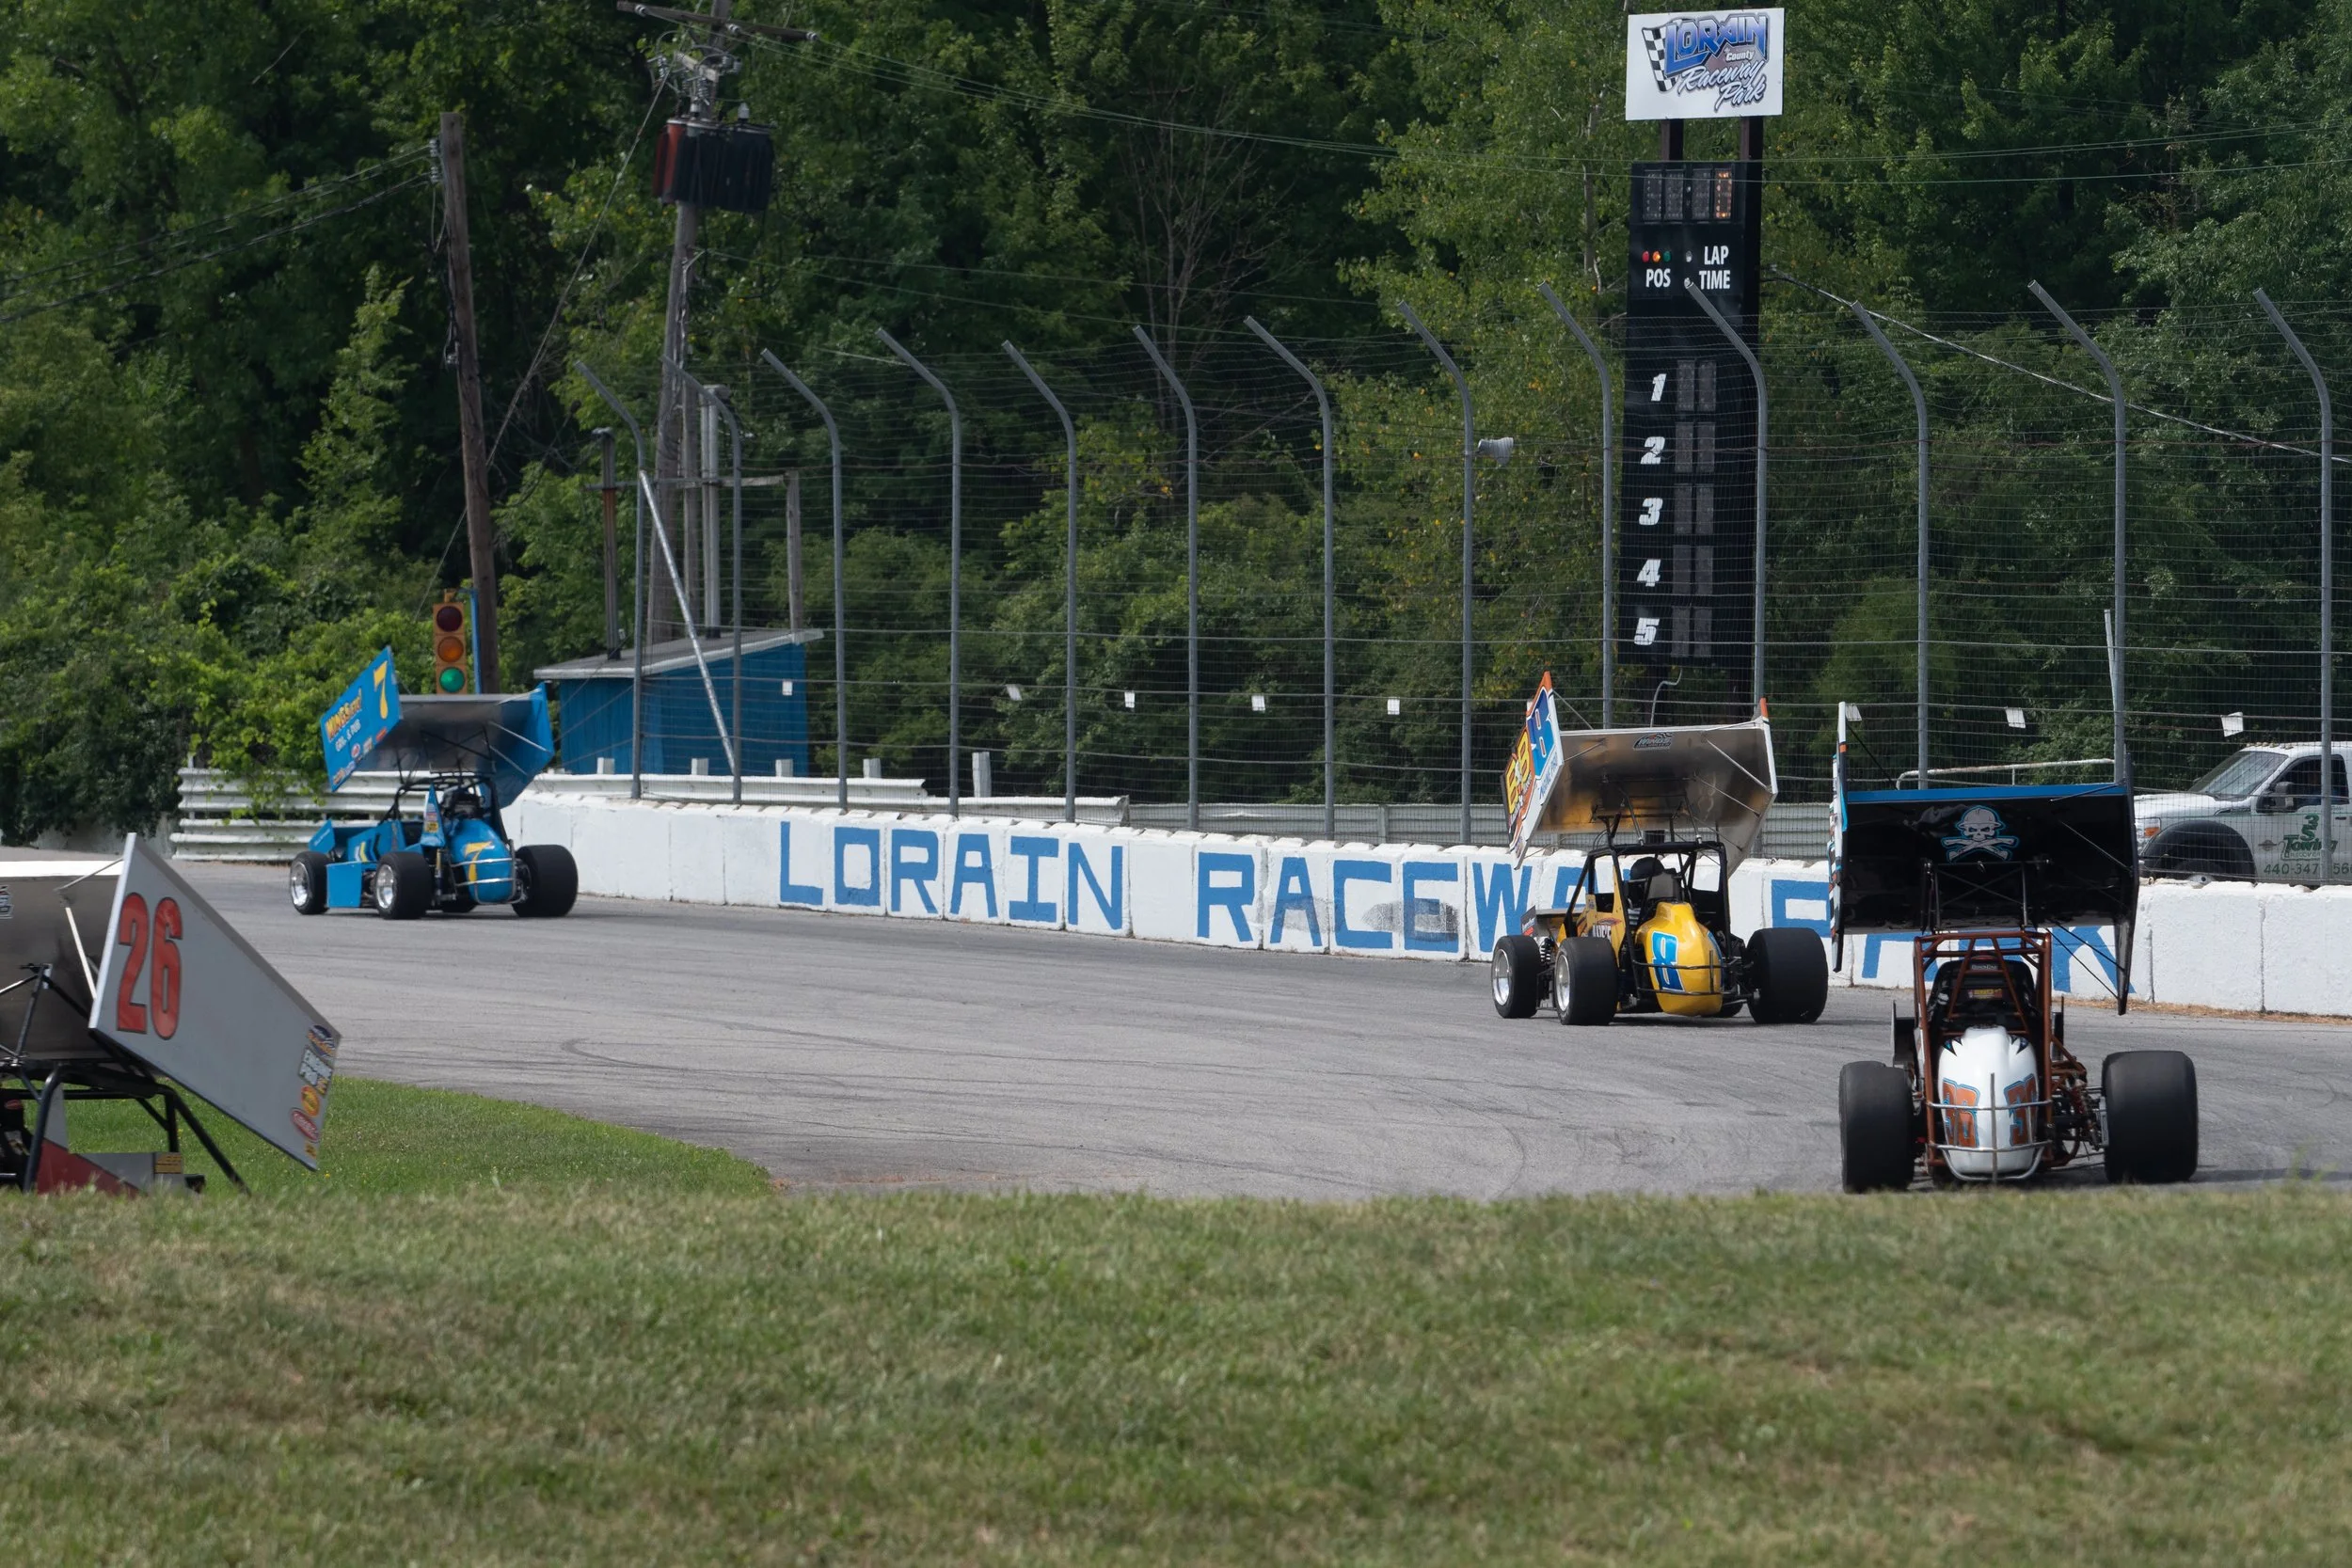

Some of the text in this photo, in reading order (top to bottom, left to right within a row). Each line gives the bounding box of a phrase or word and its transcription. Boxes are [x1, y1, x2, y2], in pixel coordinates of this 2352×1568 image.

[1664, 16, 1770, 76] LORAIN
[1725, 50, 1754, 62] County
[1678, 60, 1766, 94] Raceway
[1714, 74, 1766, 112] Park
[1704, 245, 1729, 265] LAP
[1645, 268, 1671, 288] POS
[1699, 269, 1731, 290] TIME
[1651, 373, 1667, 402] 1
[1640, 436, 1666, 465] 2
[1639, 498, 1663, 526] 3
[1636, 559, 1661, 588] 4
[1633, 618, 1661, 646] 5
[373, 660, 388, 720] 7
[2283, 834, 2339, 854] Towig
[464, 841, 493, 883] 7
[780, 821, 1124, 929] LORAIN
[1196, 851, 1633, 954] RACEWA
[117, 892, 183, 1040] 26
[1652, 930, 1686, 992] 8
